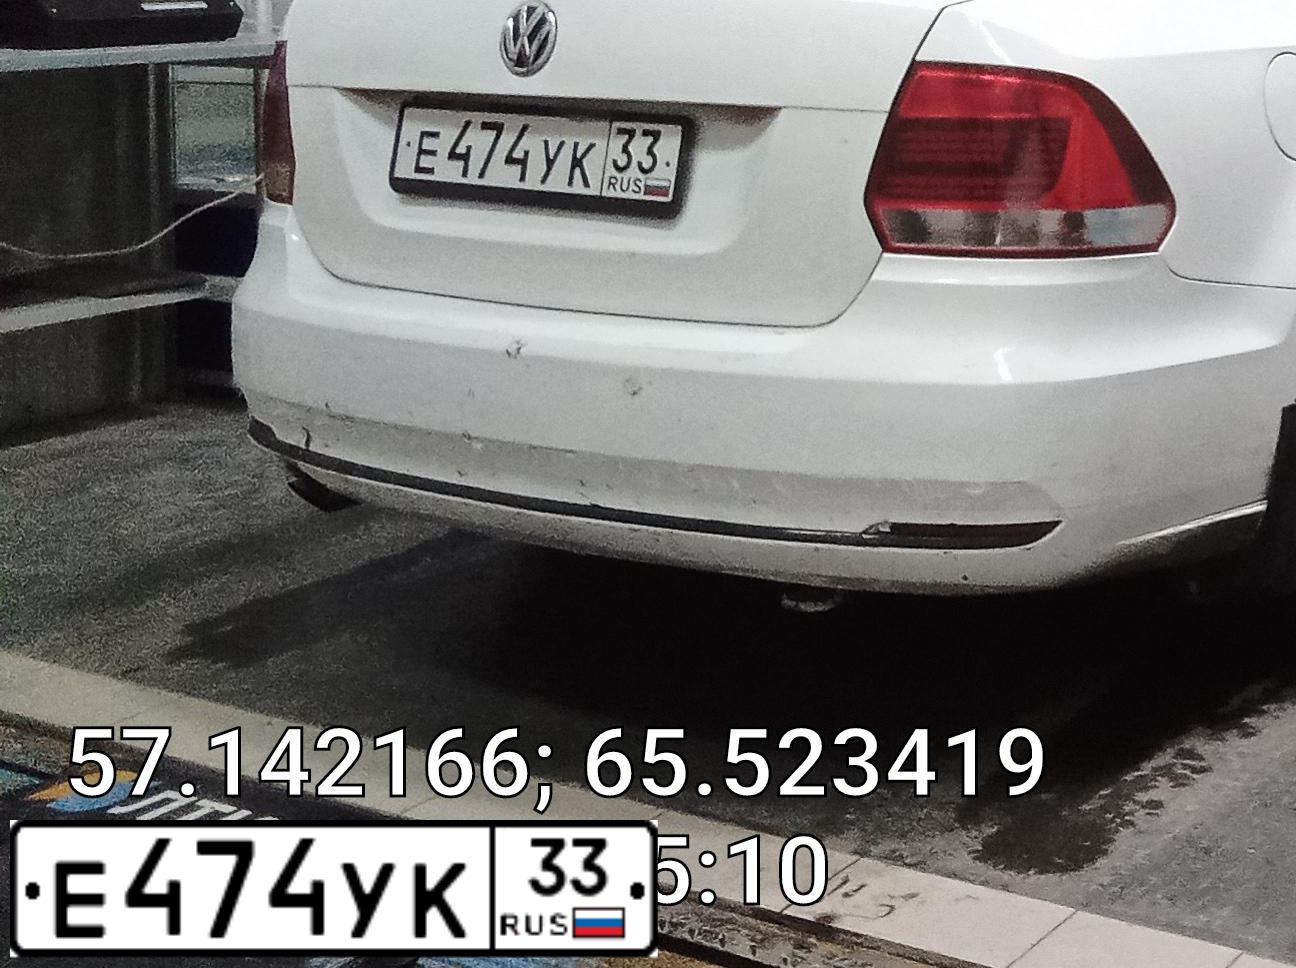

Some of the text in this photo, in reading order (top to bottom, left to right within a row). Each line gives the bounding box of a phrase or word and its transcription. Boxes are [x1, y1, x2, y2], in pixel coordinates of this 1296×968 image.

[413, 118, 596, 189] Е474УК
[612, 127, 662, 174] 33
[607, 177, 642, 194] RUS
